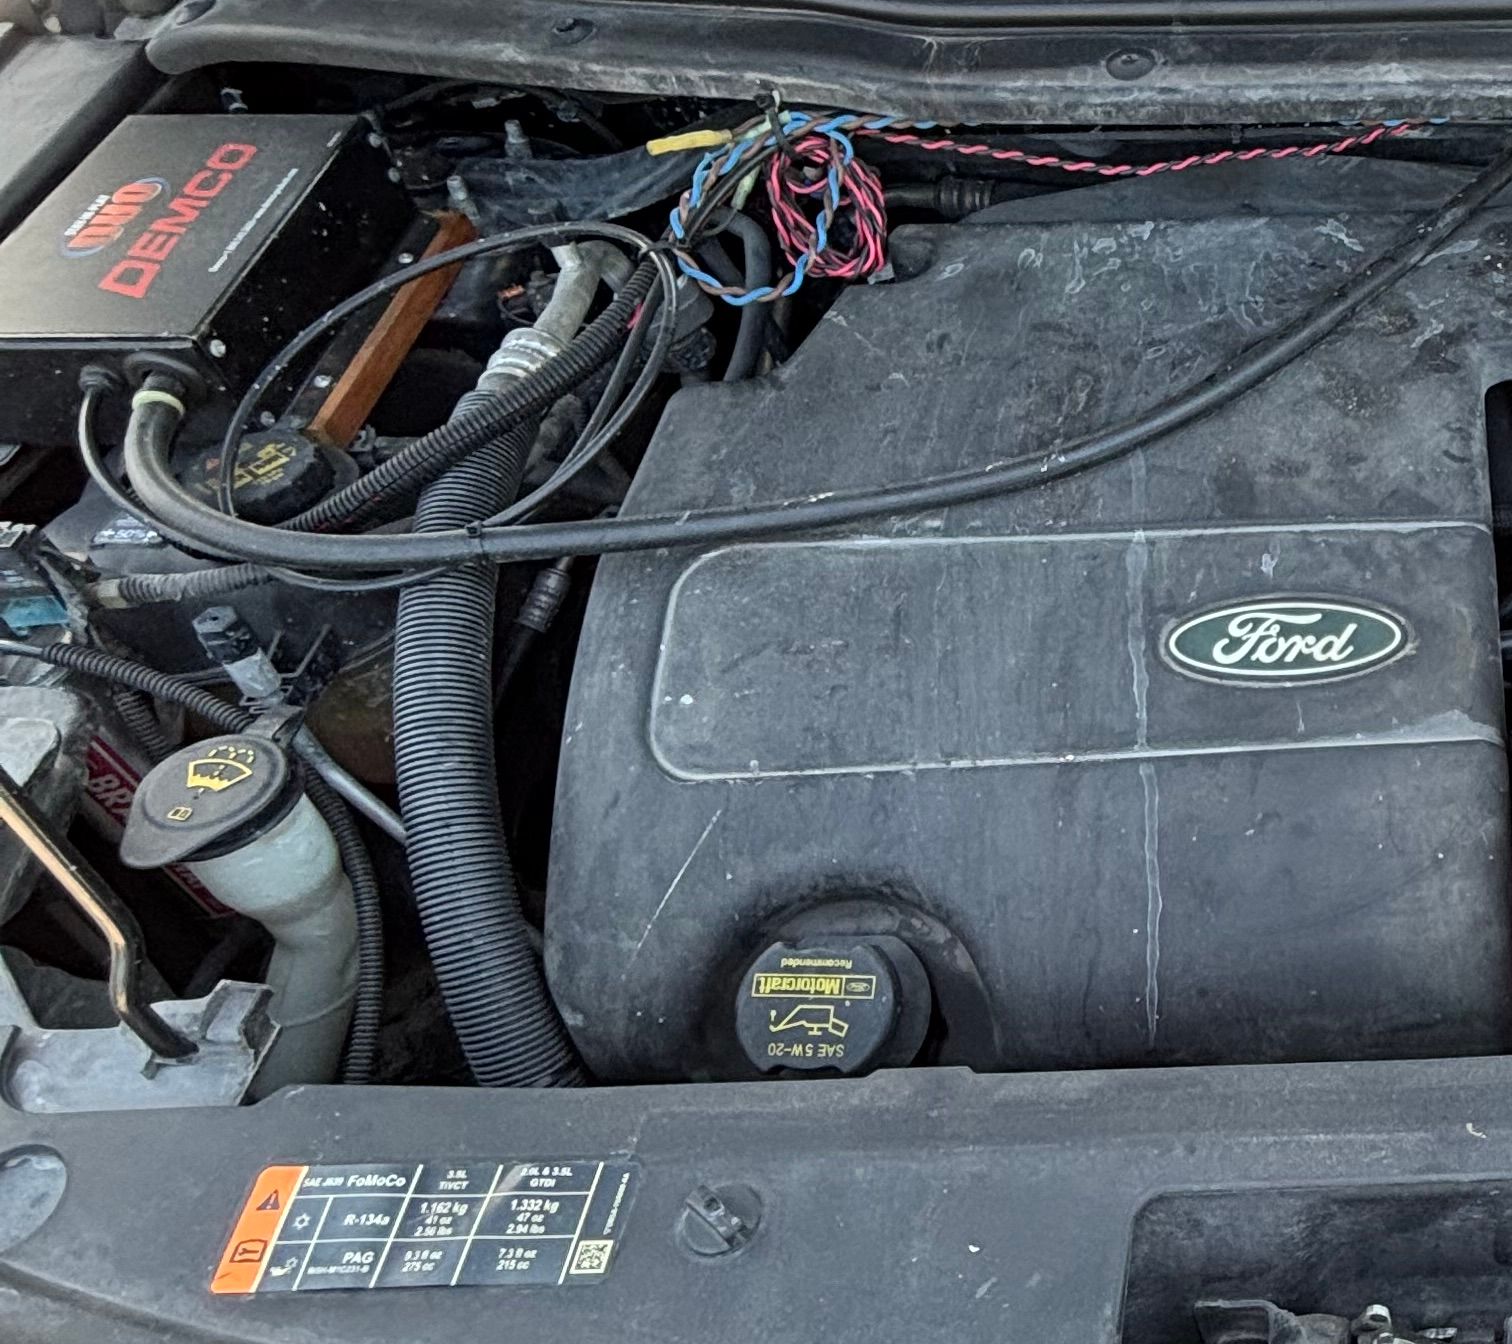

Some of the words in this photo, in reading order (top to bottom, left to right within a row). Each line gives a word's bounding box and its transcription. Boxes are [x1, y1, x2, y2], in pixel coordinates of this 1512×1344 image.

[98, 143, 257, 299] DEMCO
[1212, 612, 1358, 665] Ford
[780, 958, 853, 970] Recommended
[759, 976, 841, 994] Motorcraft
[768, 1043, 813, 1057] 5W-20
[817, 1044, 845, 1057] SAE
[552, 1167, 573, 1176] 3.5L
[347, 1174, 406, 1188] FoMoCo
[420, 1201, 452, 1214] 1.162
[452, 1201, 469, 1216] kg
[511, 1199, 543, 1211] 1.332
[543, 1199, 560, 1214] kg
[343, 1213, 391, 1226] R-134a
[439, 1216, 453, 1225] oz
[516, 1212, 531, 1222] 47
[531, 1214, 545, 1223] oz
[342, 1251, 375, 1264] PAG
[402, 1261, 422, 1272] 275
[422, 1262, 435, 1271] cc
[496, 1259, 517, 1271] 215
[516, 1260, 530, 1271] cc
